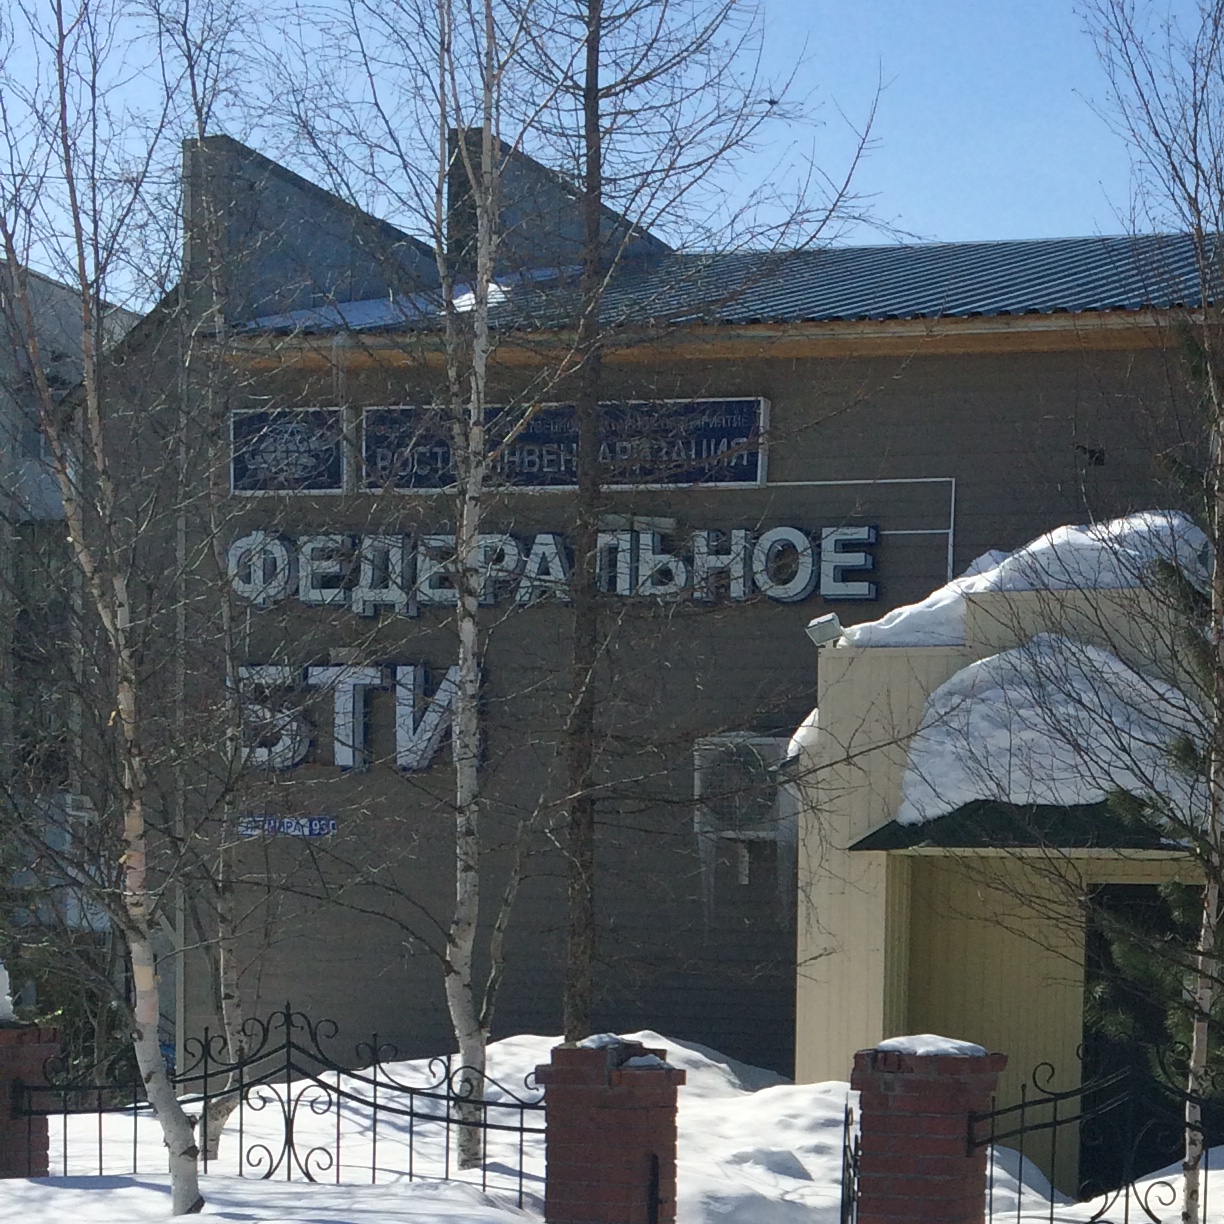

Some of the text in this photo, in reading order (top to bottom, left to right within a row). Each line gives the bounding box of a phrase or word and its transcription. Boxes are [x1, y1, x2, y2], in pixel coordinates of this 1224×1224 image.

[376, 437, 749, 476] РОСТНВЕНАРЗАЦИЯ
[227, 526, 876, 617] ФЕДЕРАЛЬНОЕ
[226, 664, 482, 772] БТИ
